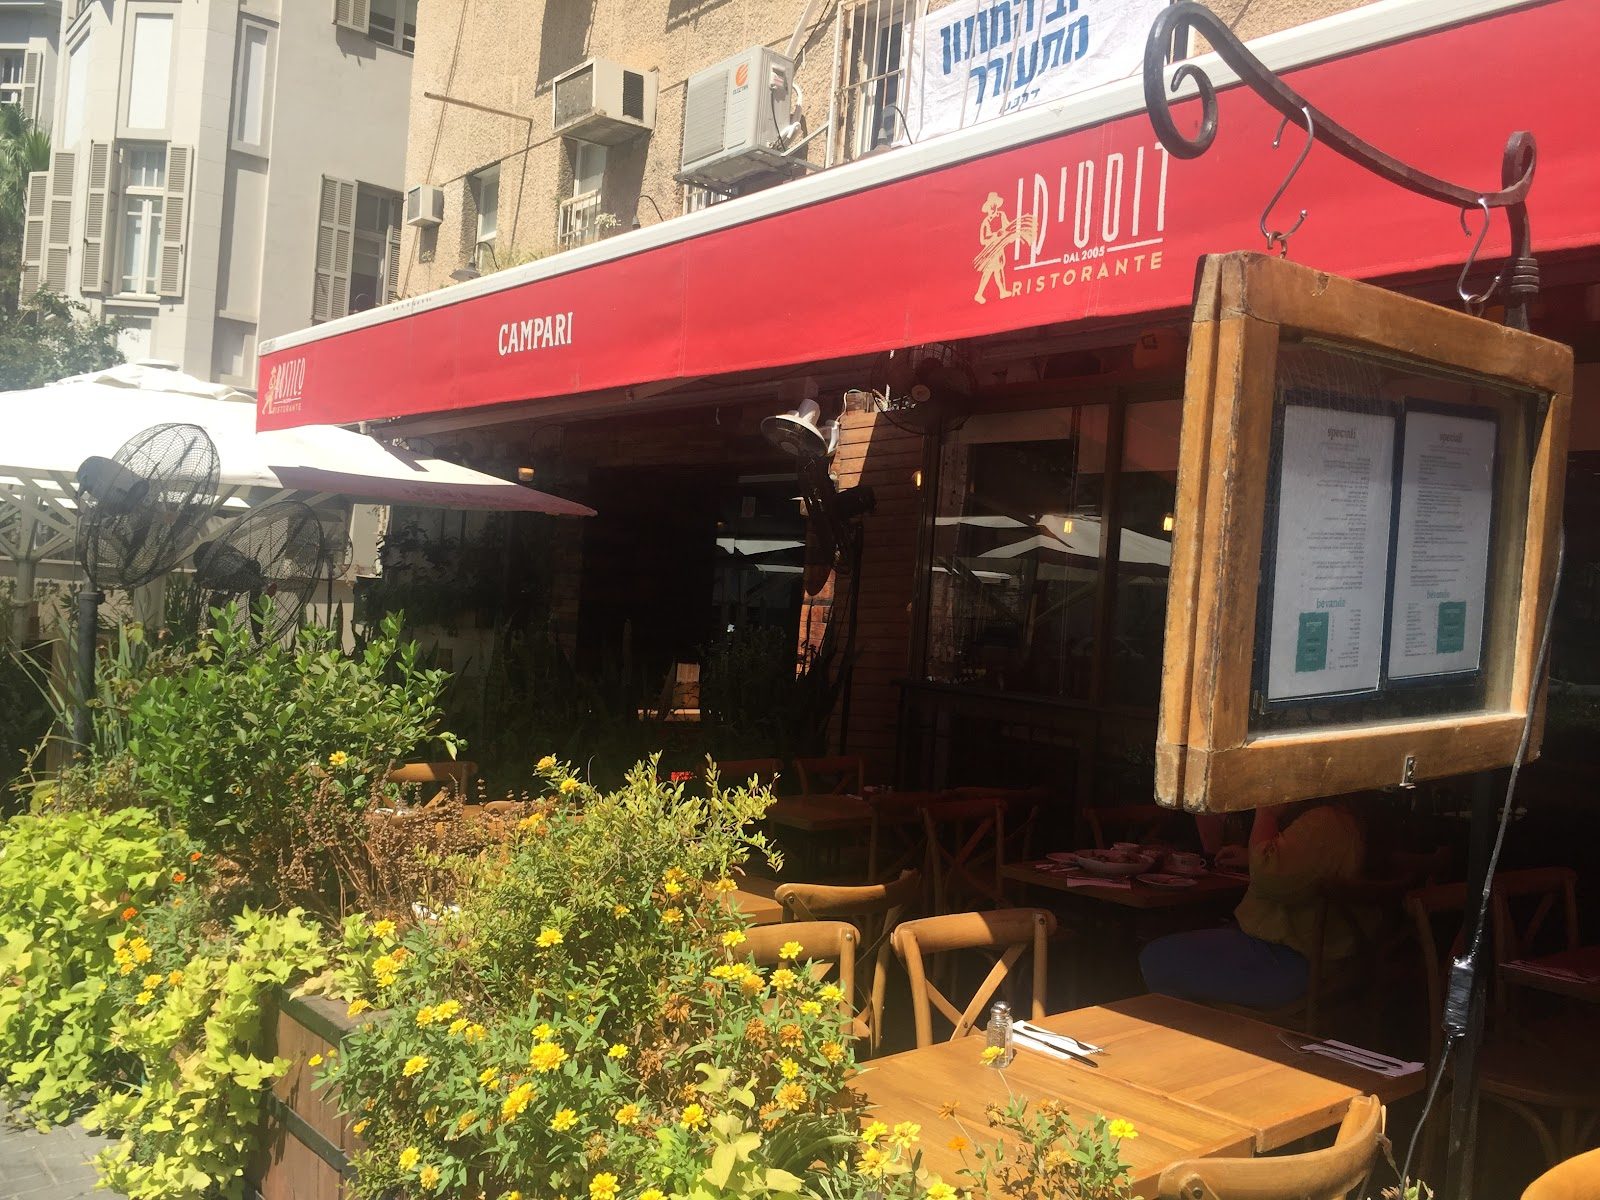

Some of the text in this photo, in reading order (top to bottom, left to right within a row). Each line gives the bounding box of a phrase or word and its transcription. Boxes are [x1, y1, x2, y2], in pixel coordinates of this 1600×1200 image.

[969, 14, 1089, 104] מתעורר
[1013, 141, 1169, 266] רוסטיקו
[1011, 251, 1164, 298] RISTORANTE
[1063, 245, 1106, 264] DAL 2005
[498, 311, 574, 356] CAMPARI
